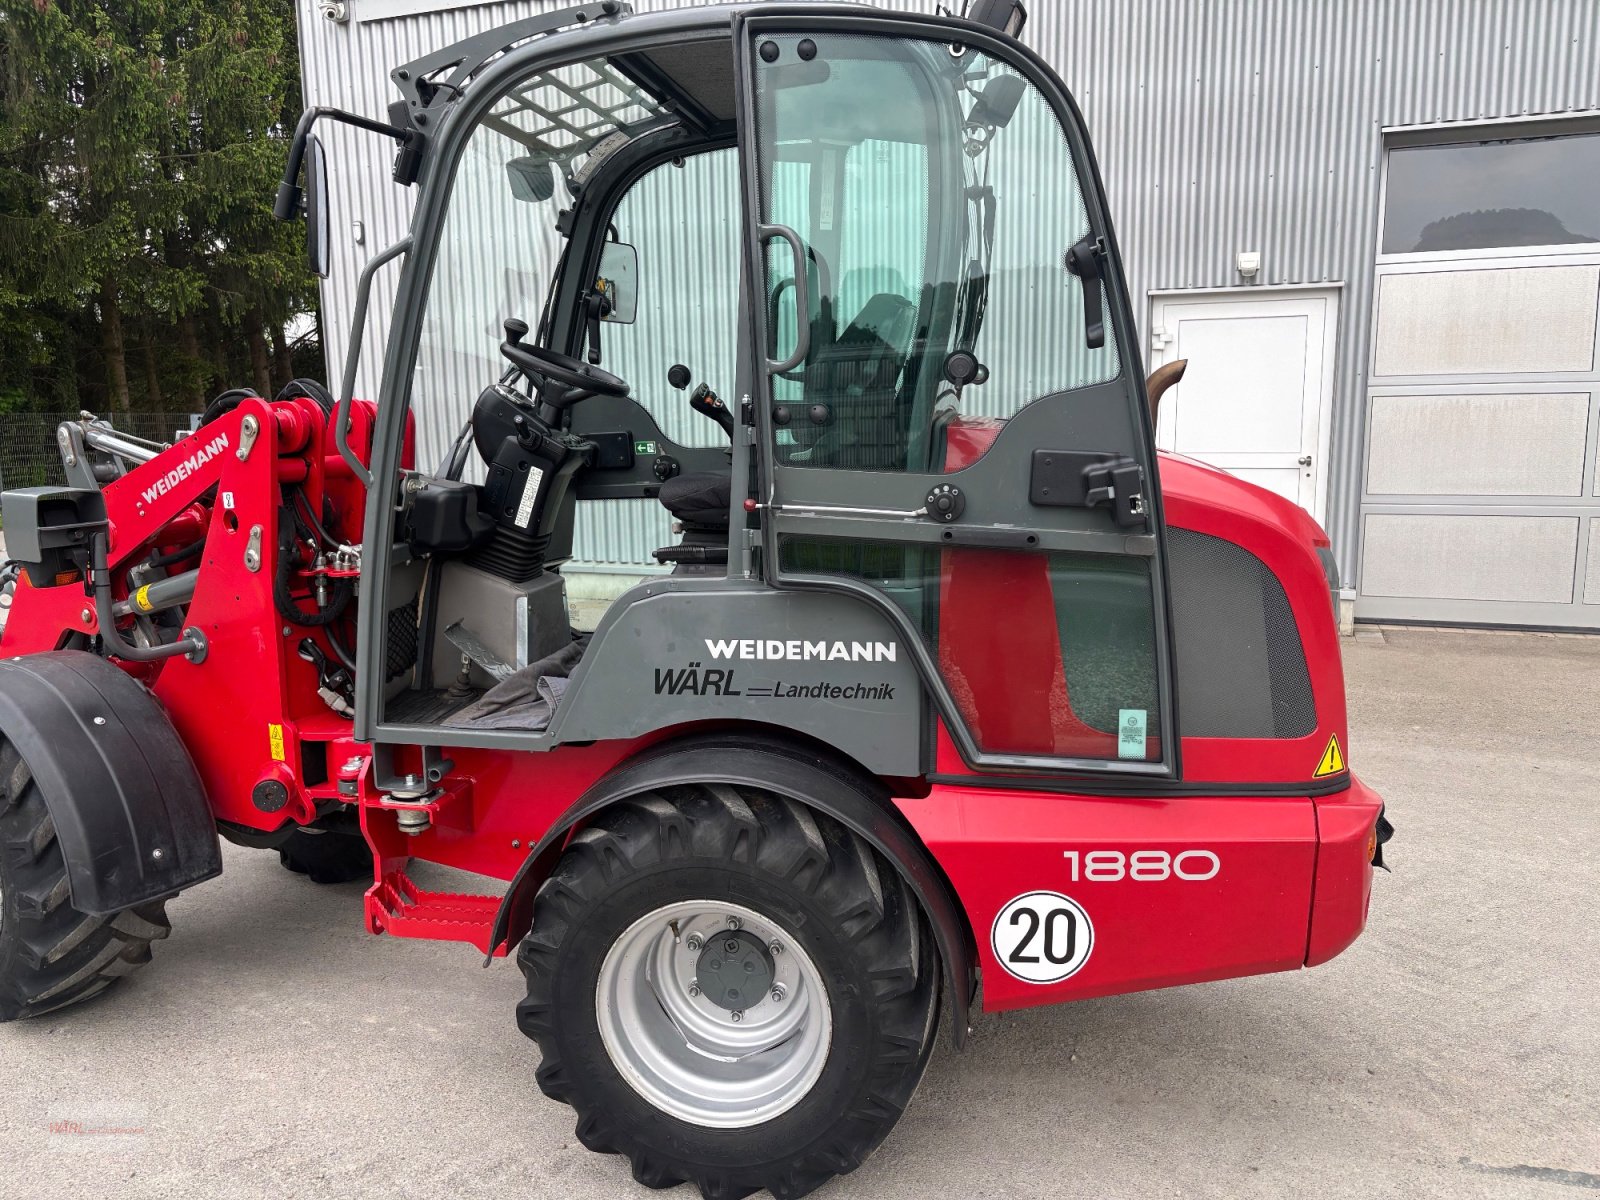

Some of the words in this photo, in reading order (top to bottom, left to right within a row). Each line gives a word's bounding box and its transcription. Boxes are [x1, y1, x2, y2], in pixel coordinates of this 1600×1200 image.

[141, 432, 229, 504] WEIDEMANN
[704, 639, 897, 662] WEIDEMANN
[654, 662, 742, 696] WÄRL
[773, 681, 896, 700] Landtechnik
[1063, 850, 1221, 881] 1880
[1009, 907, 1077, 964] 20
